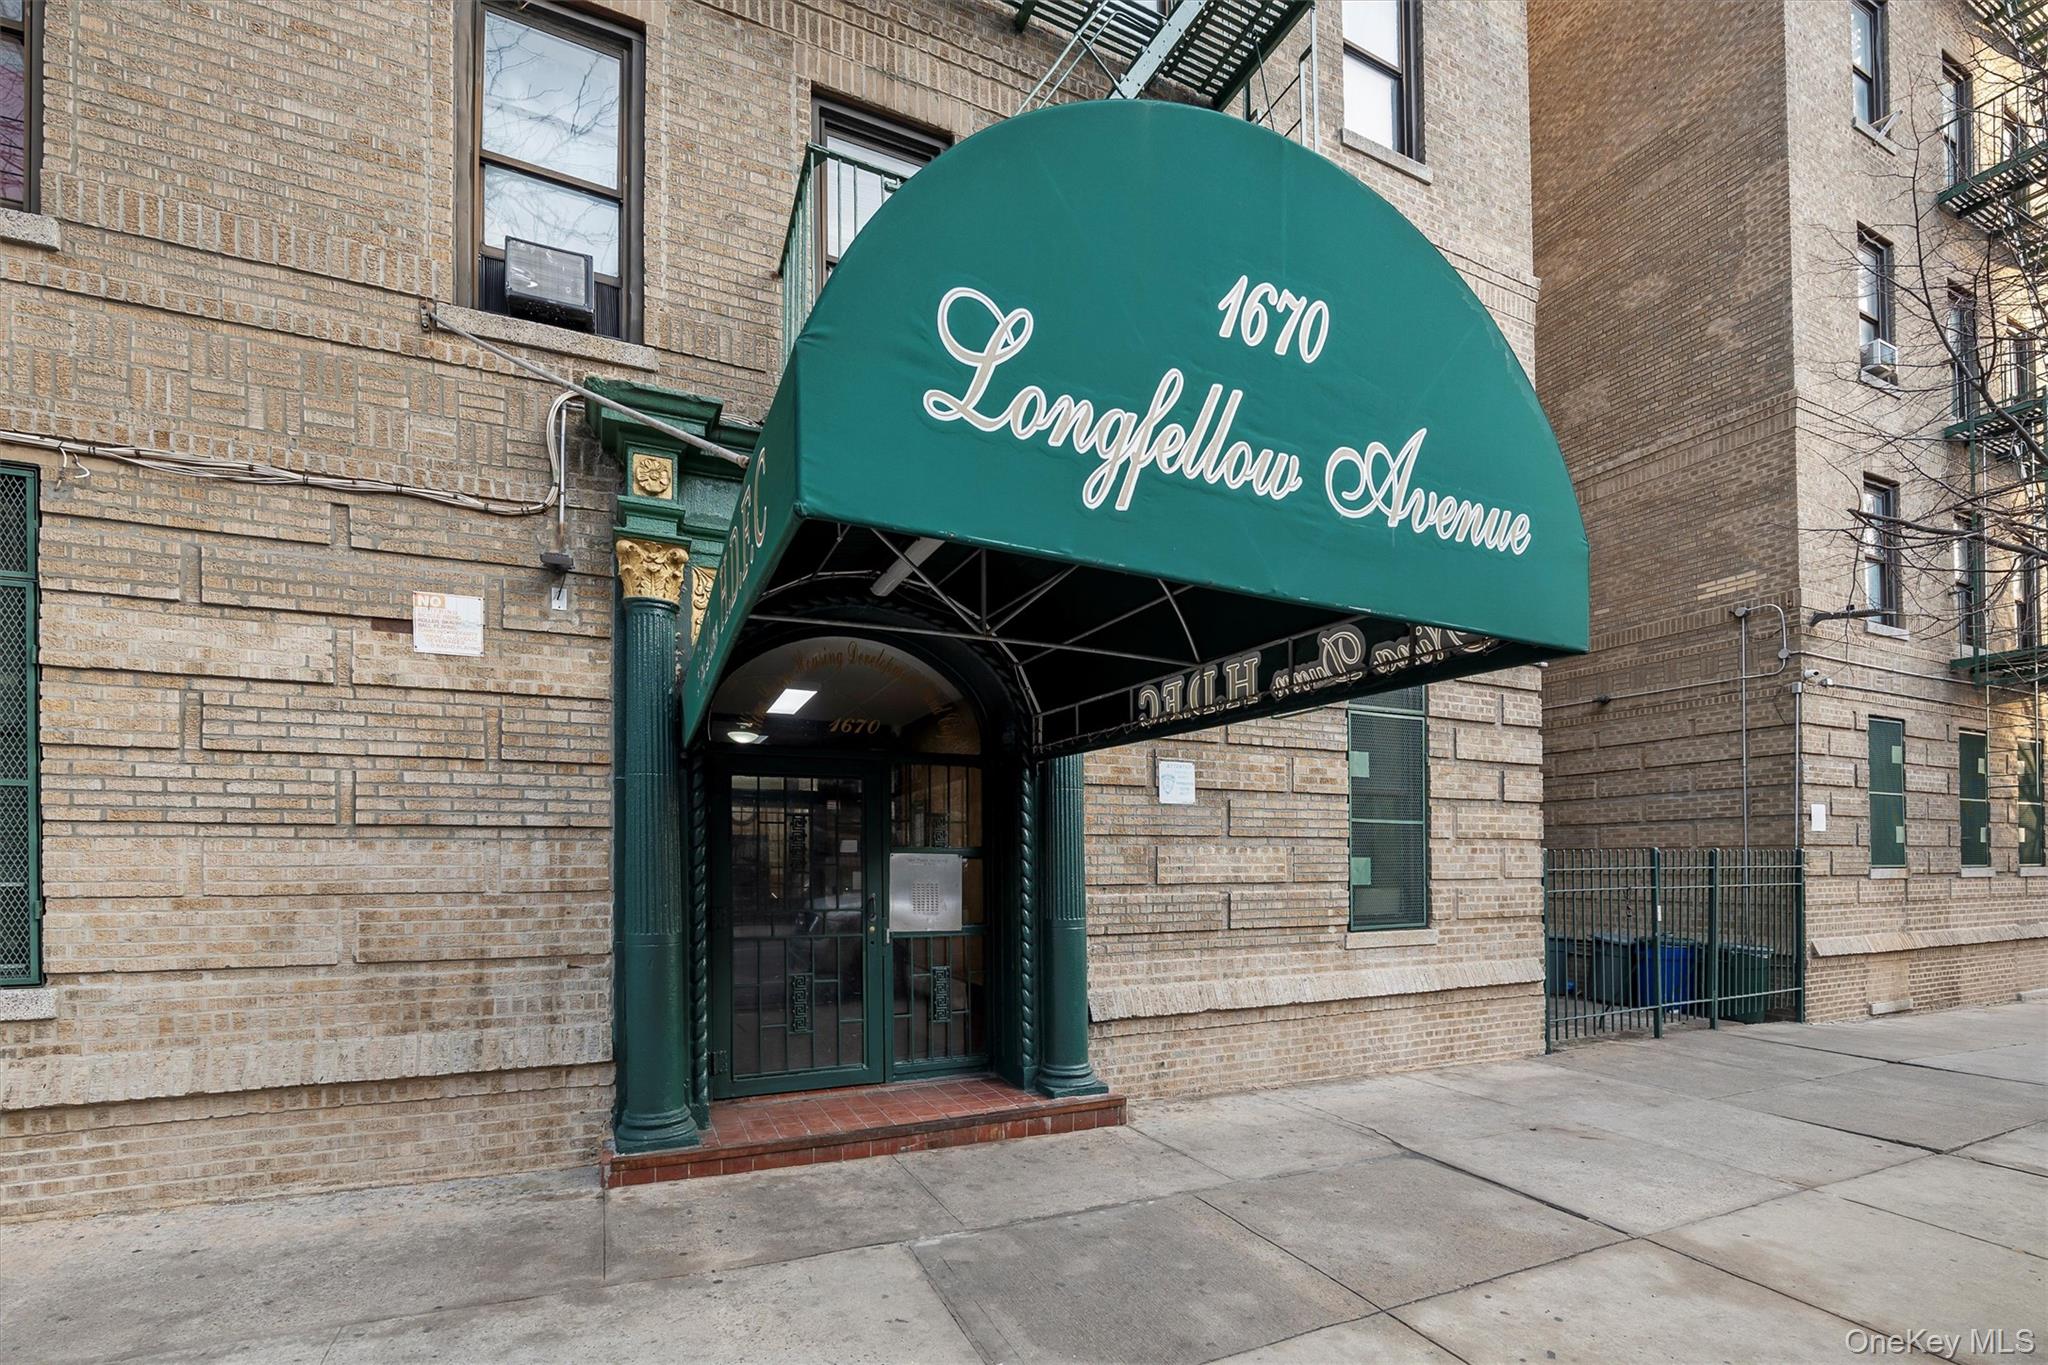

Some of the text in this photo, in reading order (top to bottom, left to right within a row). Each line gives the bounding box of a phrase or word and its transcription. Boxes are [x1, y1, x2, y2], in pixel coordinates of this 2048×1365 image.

[1216, 275, 1330, 363] 1670
[923, 286, 1532, 555] Longfellow Avenue
[417, 594, 442, 607] NO
[829, 717, 881, 735] 1670
